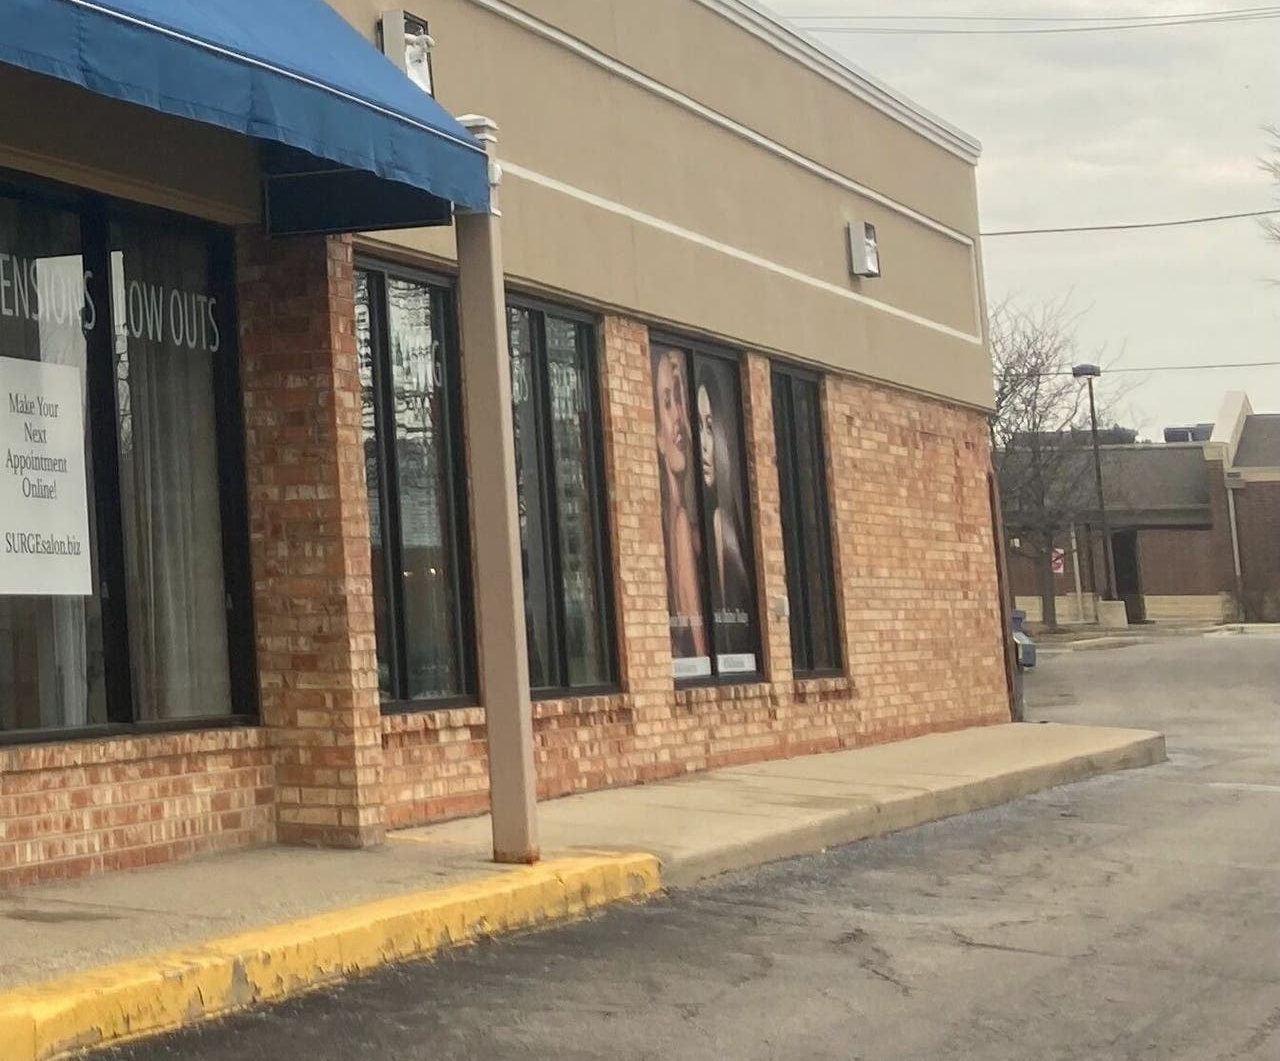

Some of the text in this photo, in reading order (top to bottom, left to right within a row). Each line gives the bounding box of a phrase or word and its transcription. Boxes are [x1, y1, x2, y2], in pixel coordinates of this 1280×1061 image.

[169, 288, 221, 353] OUTS
[8, 392, 60, 419] Make Your
[24, 421, 48, 444] Next
[5, 447, 68, 476] Appointment
[22, 476, 58, 500] Online!
[5, 531, 81, 556] SURGEsalon.biz
